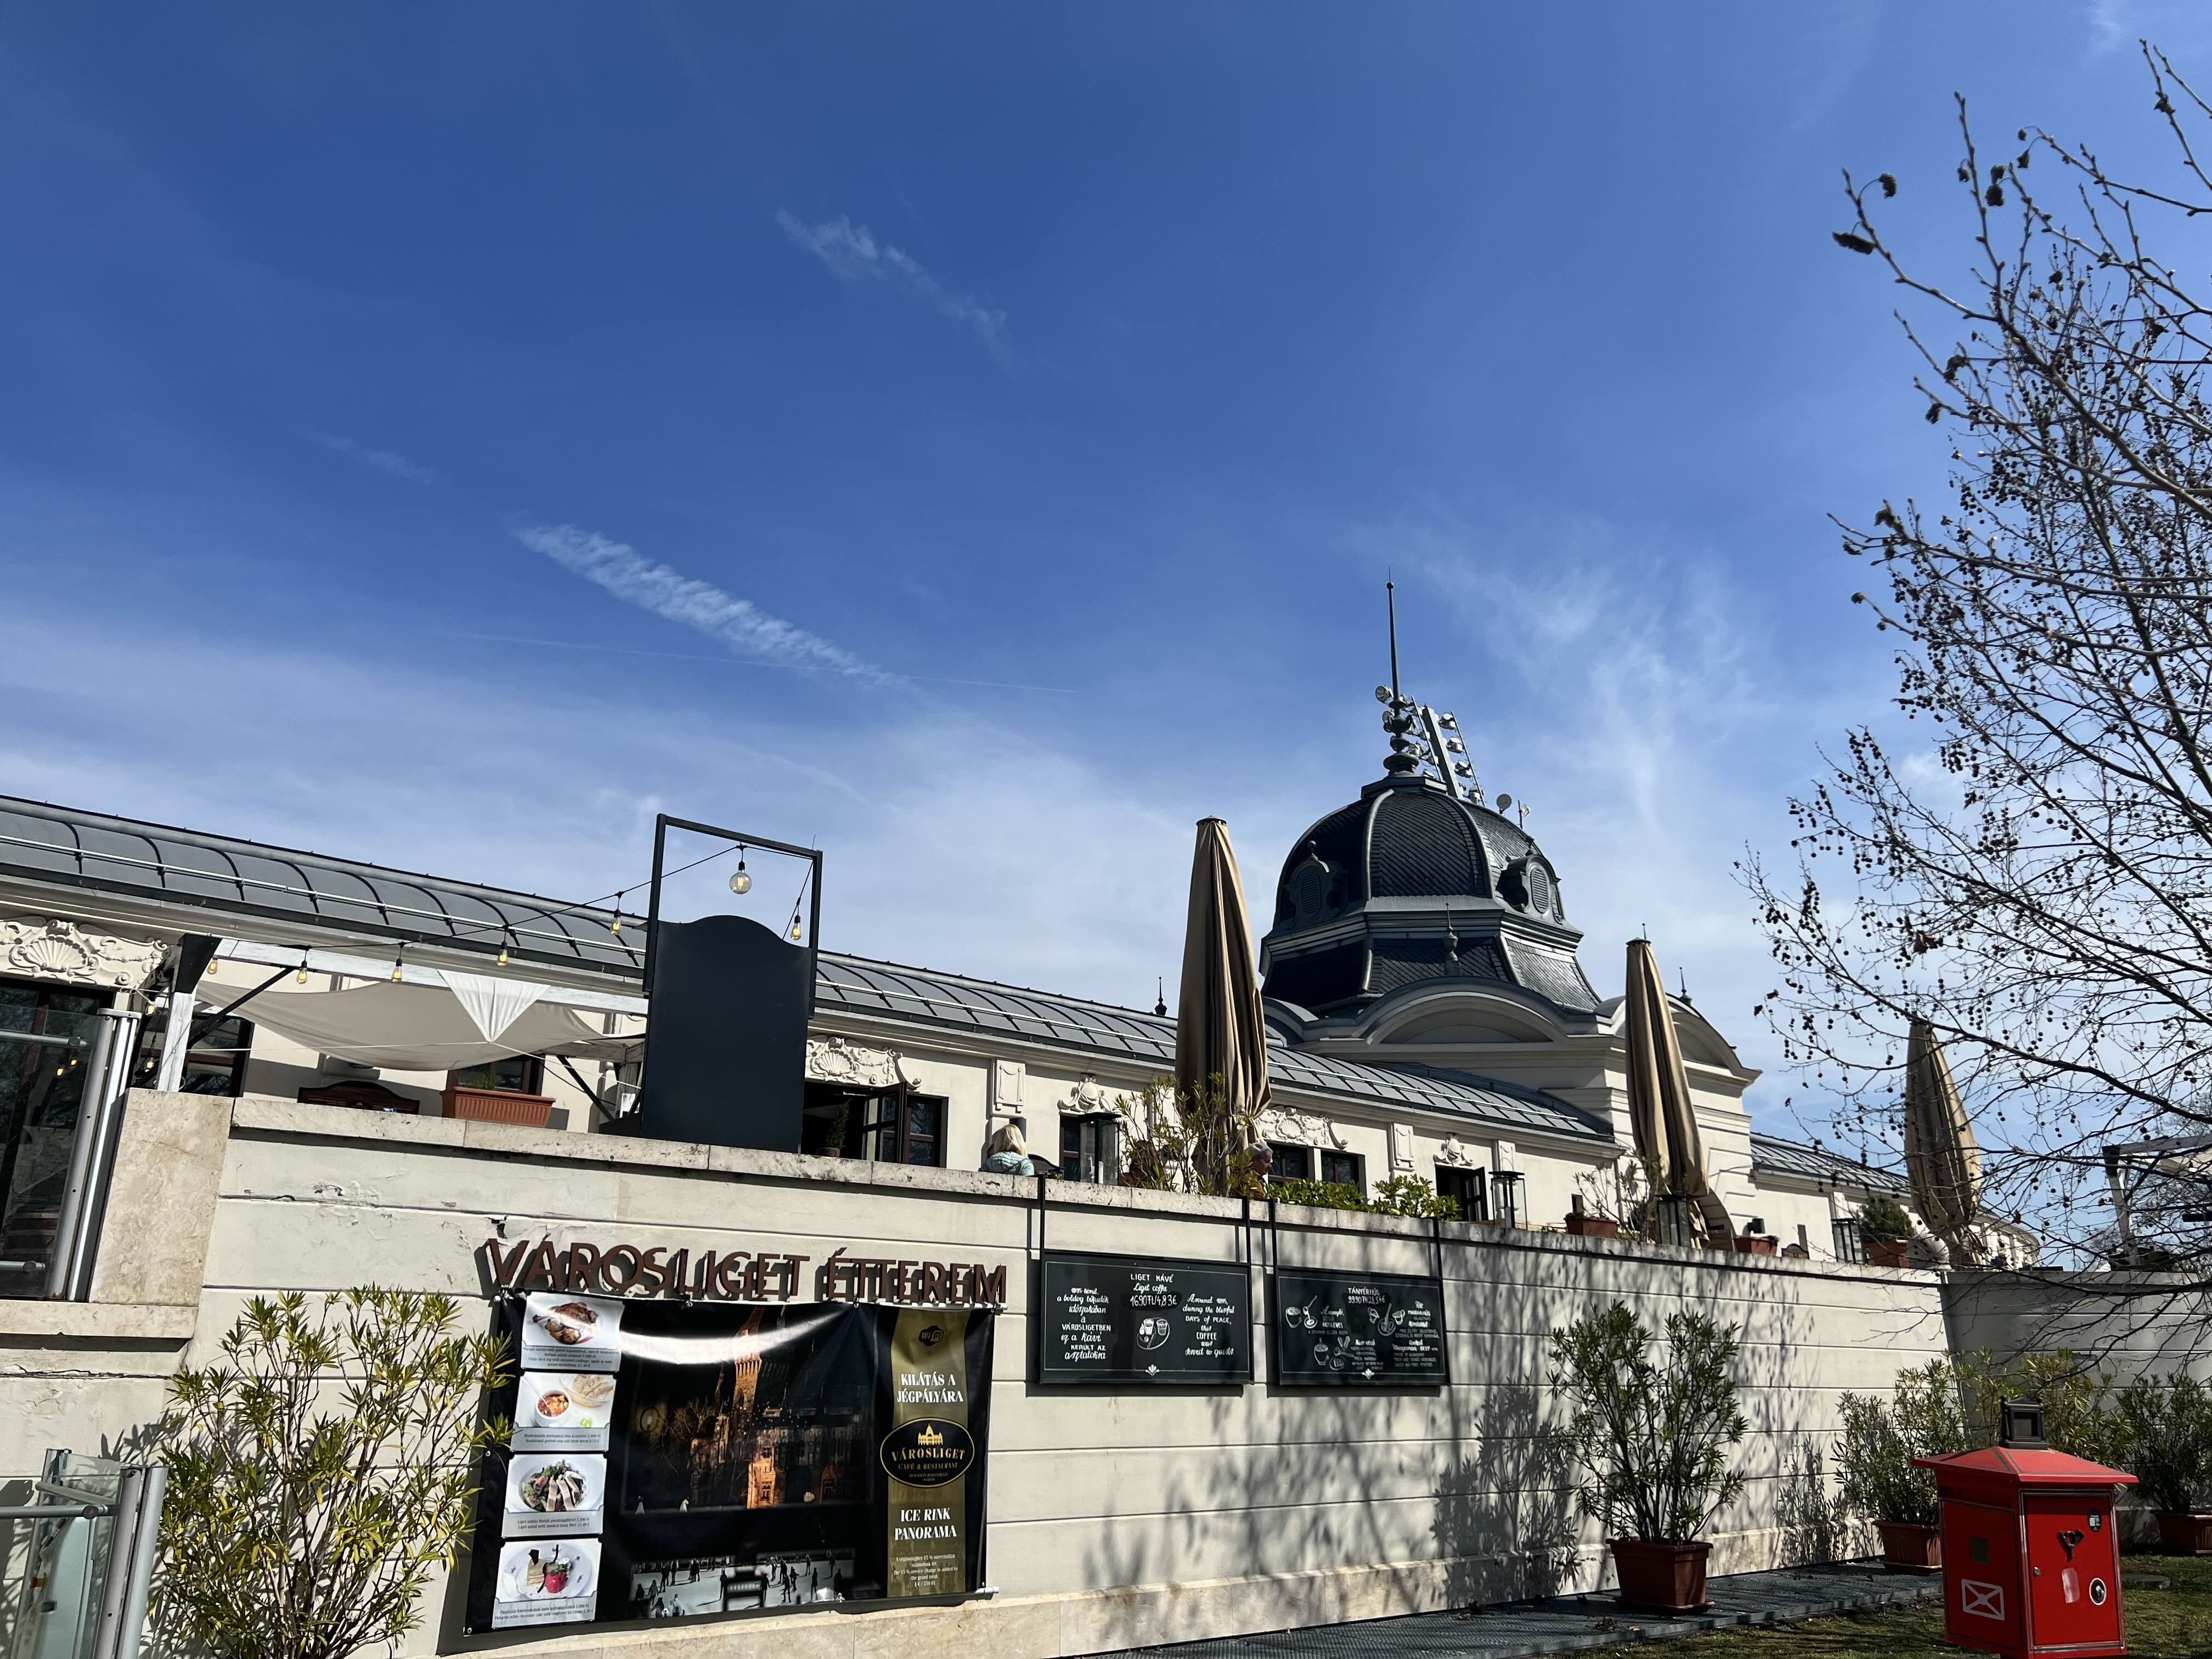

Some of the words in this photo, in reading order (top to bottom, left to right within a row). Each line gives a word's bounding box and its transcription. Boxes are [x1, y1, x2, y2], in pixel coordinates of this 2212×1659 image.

[826, 1247, 1007, 1304] ÉTTEREM
[1156, 1274, 1173, 1283] KÁVÉ
[1133, 1283, 1150, 1294] Liget
[1063, 1294, 1084, 1305] boldog
[1187, 1293, 1212, 1304] Around
[1183, 1304, 1203, 1314] during
[1204, 1316, 1210, 1324] of
[1212, 1317, 1232, 1325] PEACE,
[1062, 1322, 1111, 1332] VÁROSLIGETBEN
[1196, 1332, 1217, 1340] COFFEE
[901, 1372, 945, 1386] KILÁTÁS
[948, 1374, 956, 1386] A
[896, 1388, 964, 1403] JÉGPÁLYÁRA
[891, 1447, 965, 1462] VÁROSLIGET
[898, 1462, 915, 1470] CAFÉ
[923, 1462, 958, 1470] RESTAURANT
[901, 1509, 921, 1522] ICE
[924, 1508, 950, 1521] RINK
[895, 1525, 957, 1541] PANORAMA
